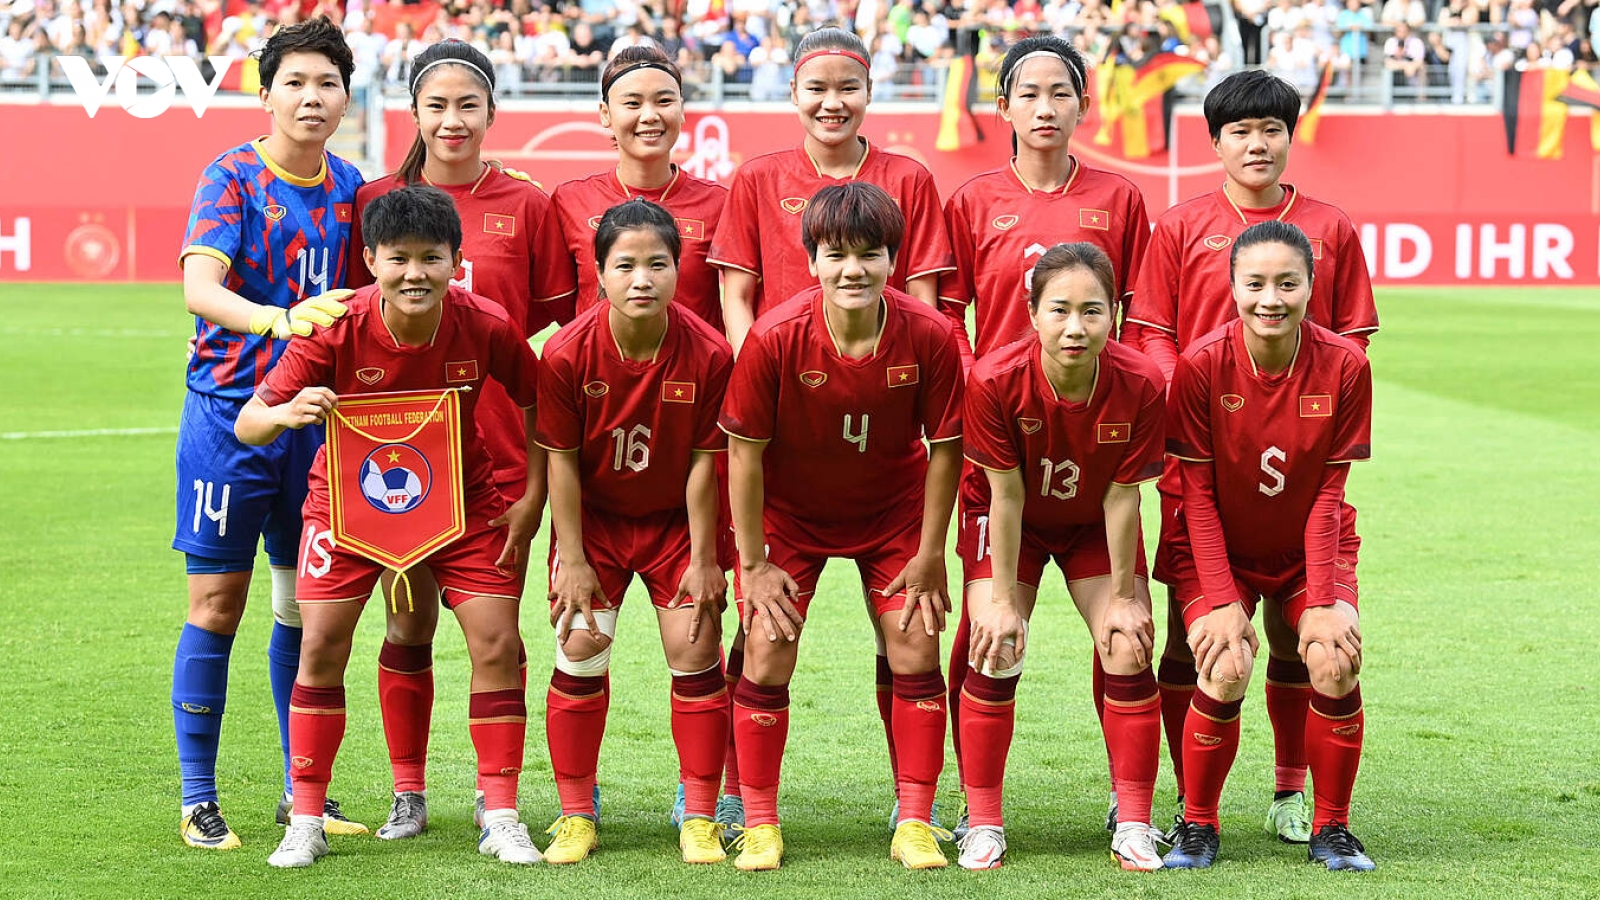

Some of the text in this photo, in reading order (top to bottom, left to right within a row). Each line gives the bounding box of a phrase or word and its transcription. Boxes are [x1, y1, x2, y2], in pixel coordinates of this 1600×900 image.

[297, 246, 329, 300] 14
[1455, 223, 1575, 279] IHR
[369, 412, 403, 426] FOOTBALL
[842, 413, 869, 453] 4
[611, 423, 651, 473] 16
[386, 494, 408, 504] VFF
[1040, 457, 1081, 500] 13
[193, 479, 231, 537] 14
